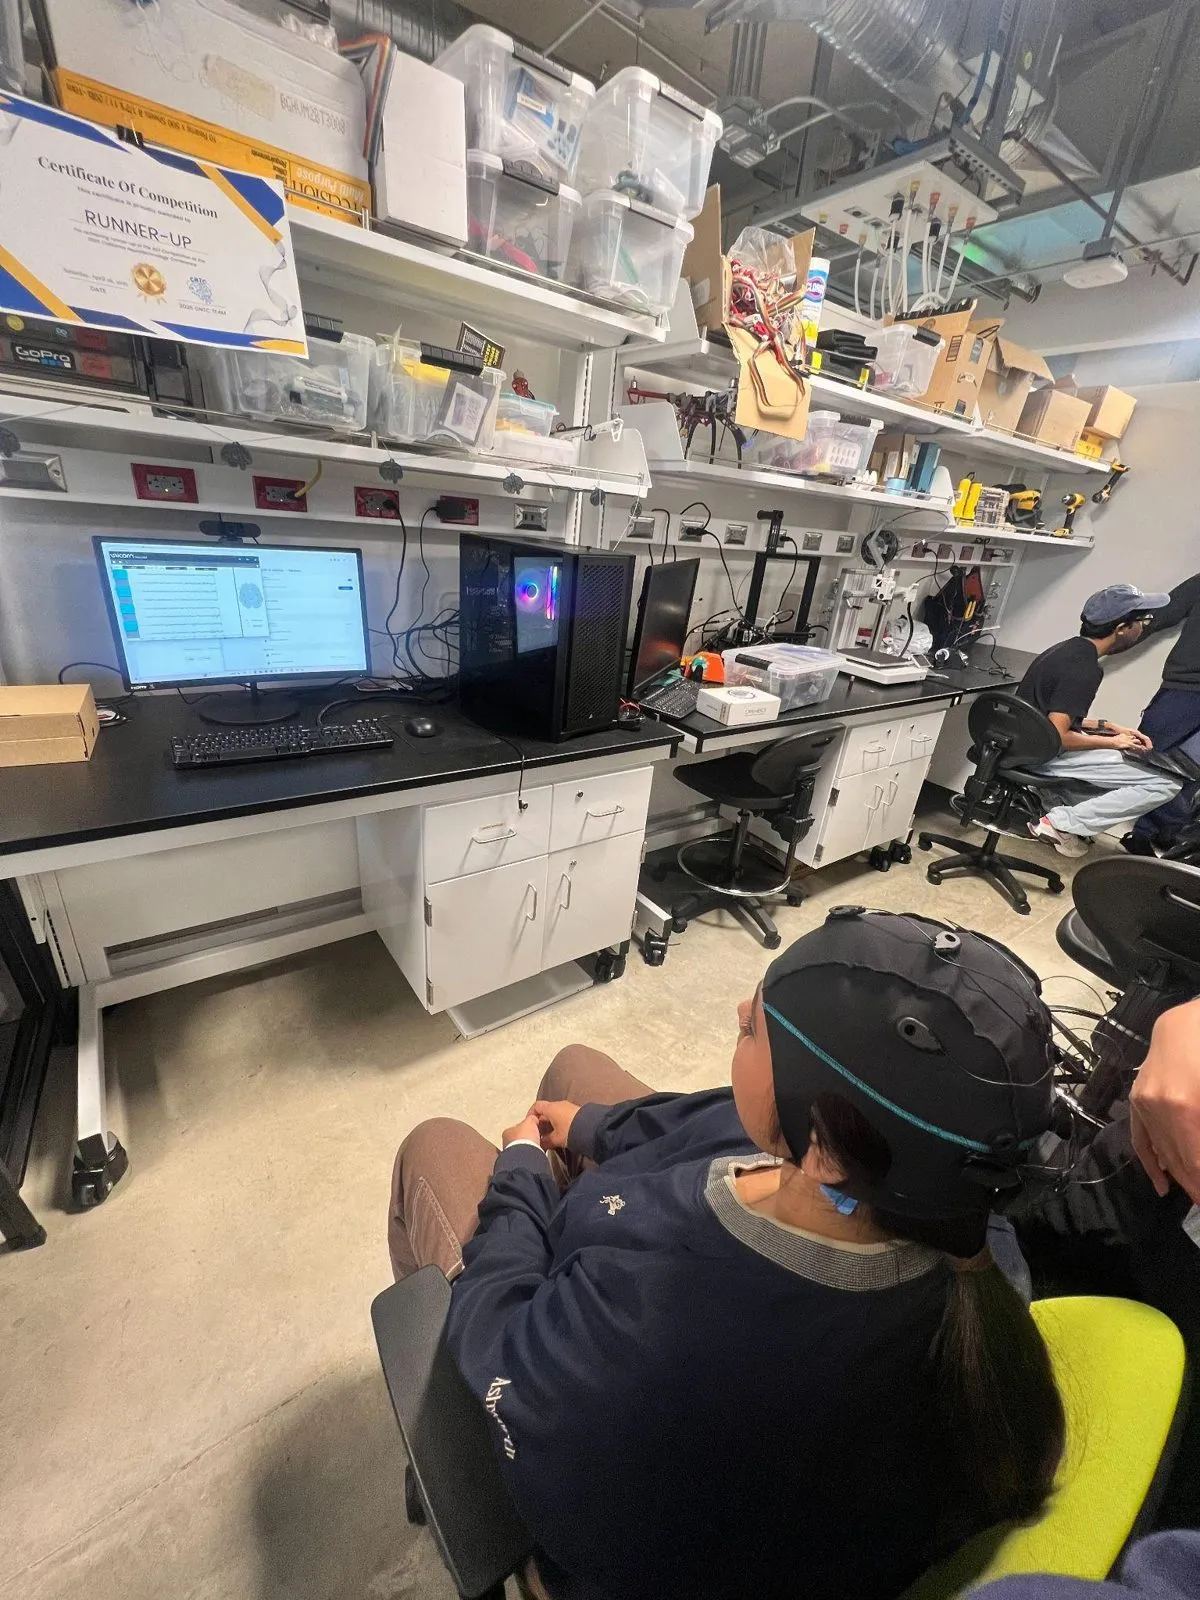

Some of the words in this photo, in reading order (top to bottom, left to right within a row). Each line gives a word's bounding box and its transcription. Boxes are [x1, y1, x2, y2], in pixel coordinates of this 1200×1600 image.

[38, 156, 115, 189] Certificate
[119, 179, 136, 194] Of
[139, 186, 218, 220] Competition
[84, 209, 191, 249] RUNNER-UP
[15, 346, 70, 361] GoPro
